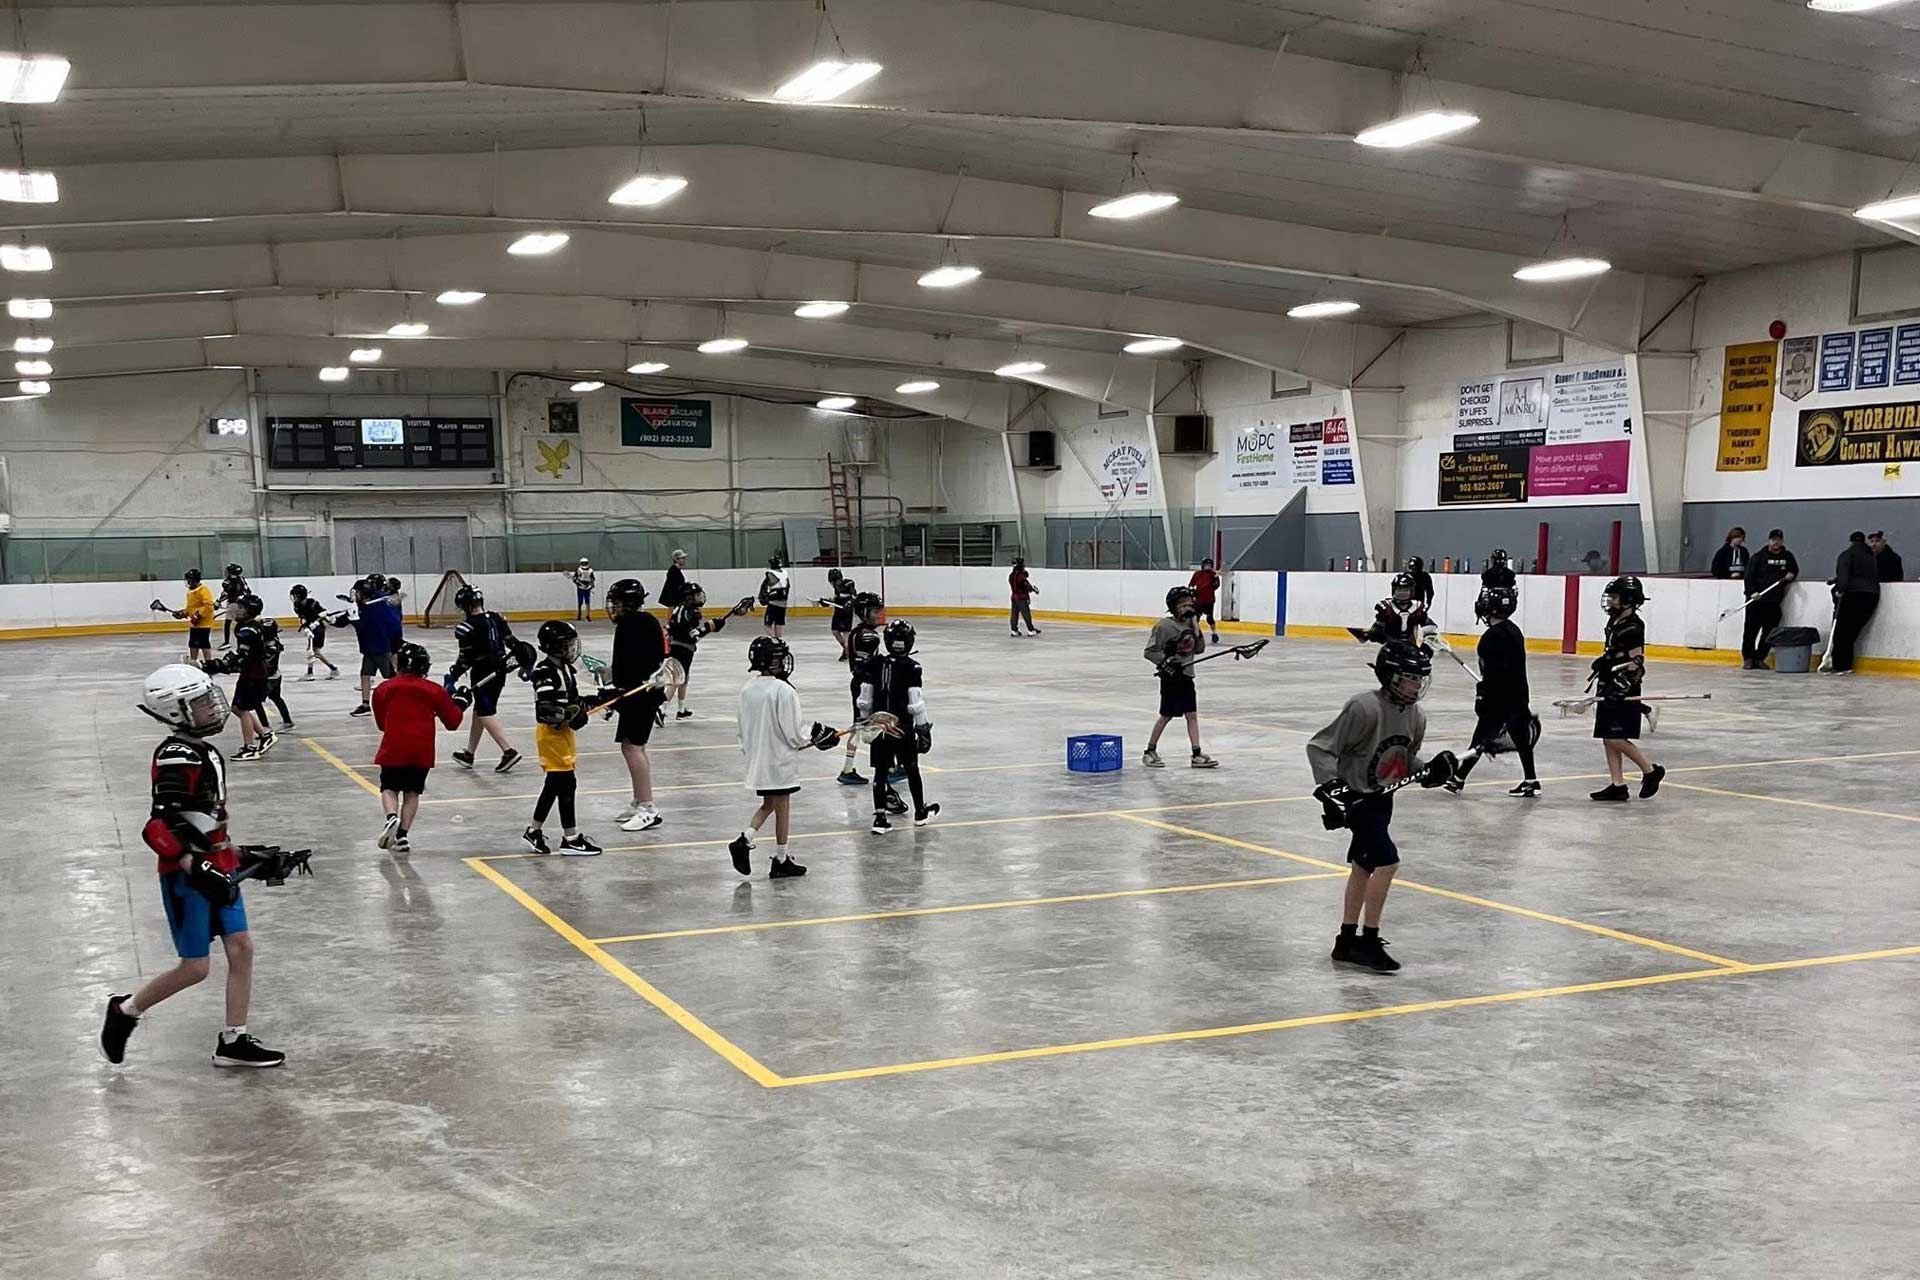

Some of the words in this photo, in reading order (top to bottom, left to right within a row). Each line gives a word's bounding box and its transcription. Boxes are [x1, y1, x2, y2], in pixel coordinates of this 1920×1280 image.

[1460, 385, 1480, 395] DON'T
[1481, 384, 1494, 393] GET
[1460, 395, 1490, 405] CHECKED
[1459, 408, 1468, 417] BY
[1470, 406, 1487, 416] LIFE'S
[1504, 402, 1536, 415] MUNRO
[652, 419, 697, 427] EXCAVATION
[1731, 440, 1754, 448] HAWKS
[1840, 437, 1880, 460] GOLDEN
[1886, 434, 1920, 458] HAWK
[1467, 453, 1499, 462] Swallows
[1553, 454, 1574, 462] around
[1458, 464, 1483, 472] Service
[1484, 462, 1508, 471] Centre
[1550, 464, 1576, 472] different
